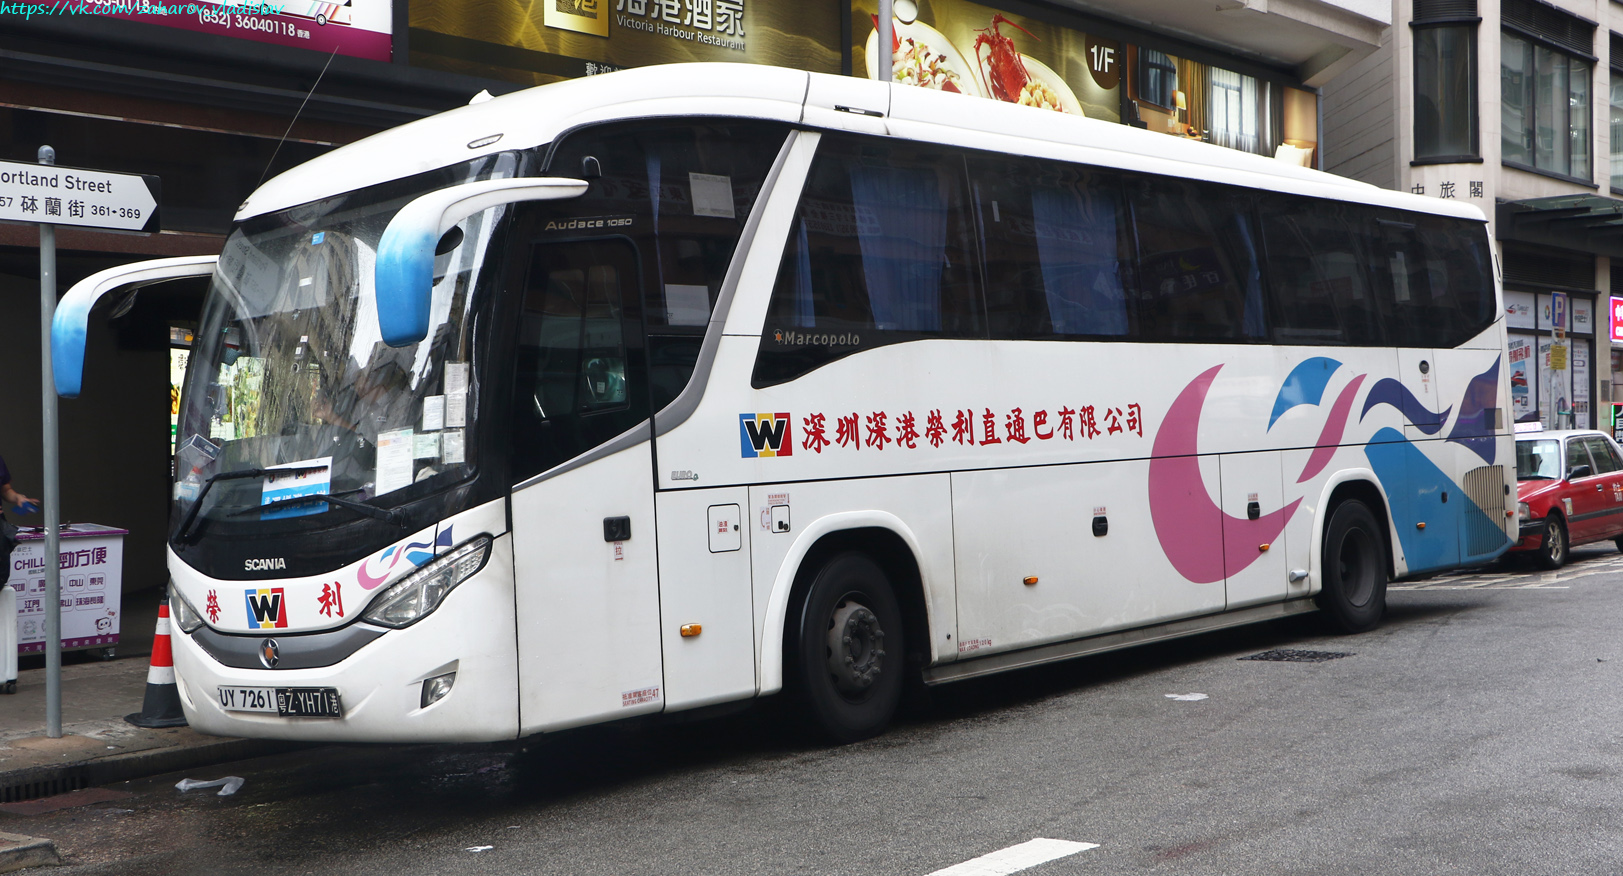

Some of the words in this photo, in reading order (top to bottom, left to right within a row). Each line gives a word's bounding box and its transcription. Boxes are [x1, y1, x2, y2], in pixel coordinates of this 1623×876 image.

[198, 11, 231, 29] (852)
[235, 15, 296, 37] 36040118
[616, 14, 654, 32] Victoria
[656, 23, 695, 41] Harbour
[697, 31, 745, 51] Restaurant
[1090, 44, 1115, 73] 1/F
[65, 175, 112, 194] Street
[544, 218, 604, 231] Audace
[606, 217, 633, 228] 1050
[784, 330, 860, 346] Marcopolo
[801, 402, 1143, 454] 深圳深港榮利直通巴有限公司
[244, 558, 286, 572] SCANIA
[69, 578, 83, 587] 中山
[317, 581, 344, 618] 利
[219, 689, 235, 708] UY
[239, 690, 273, 709] 7261
